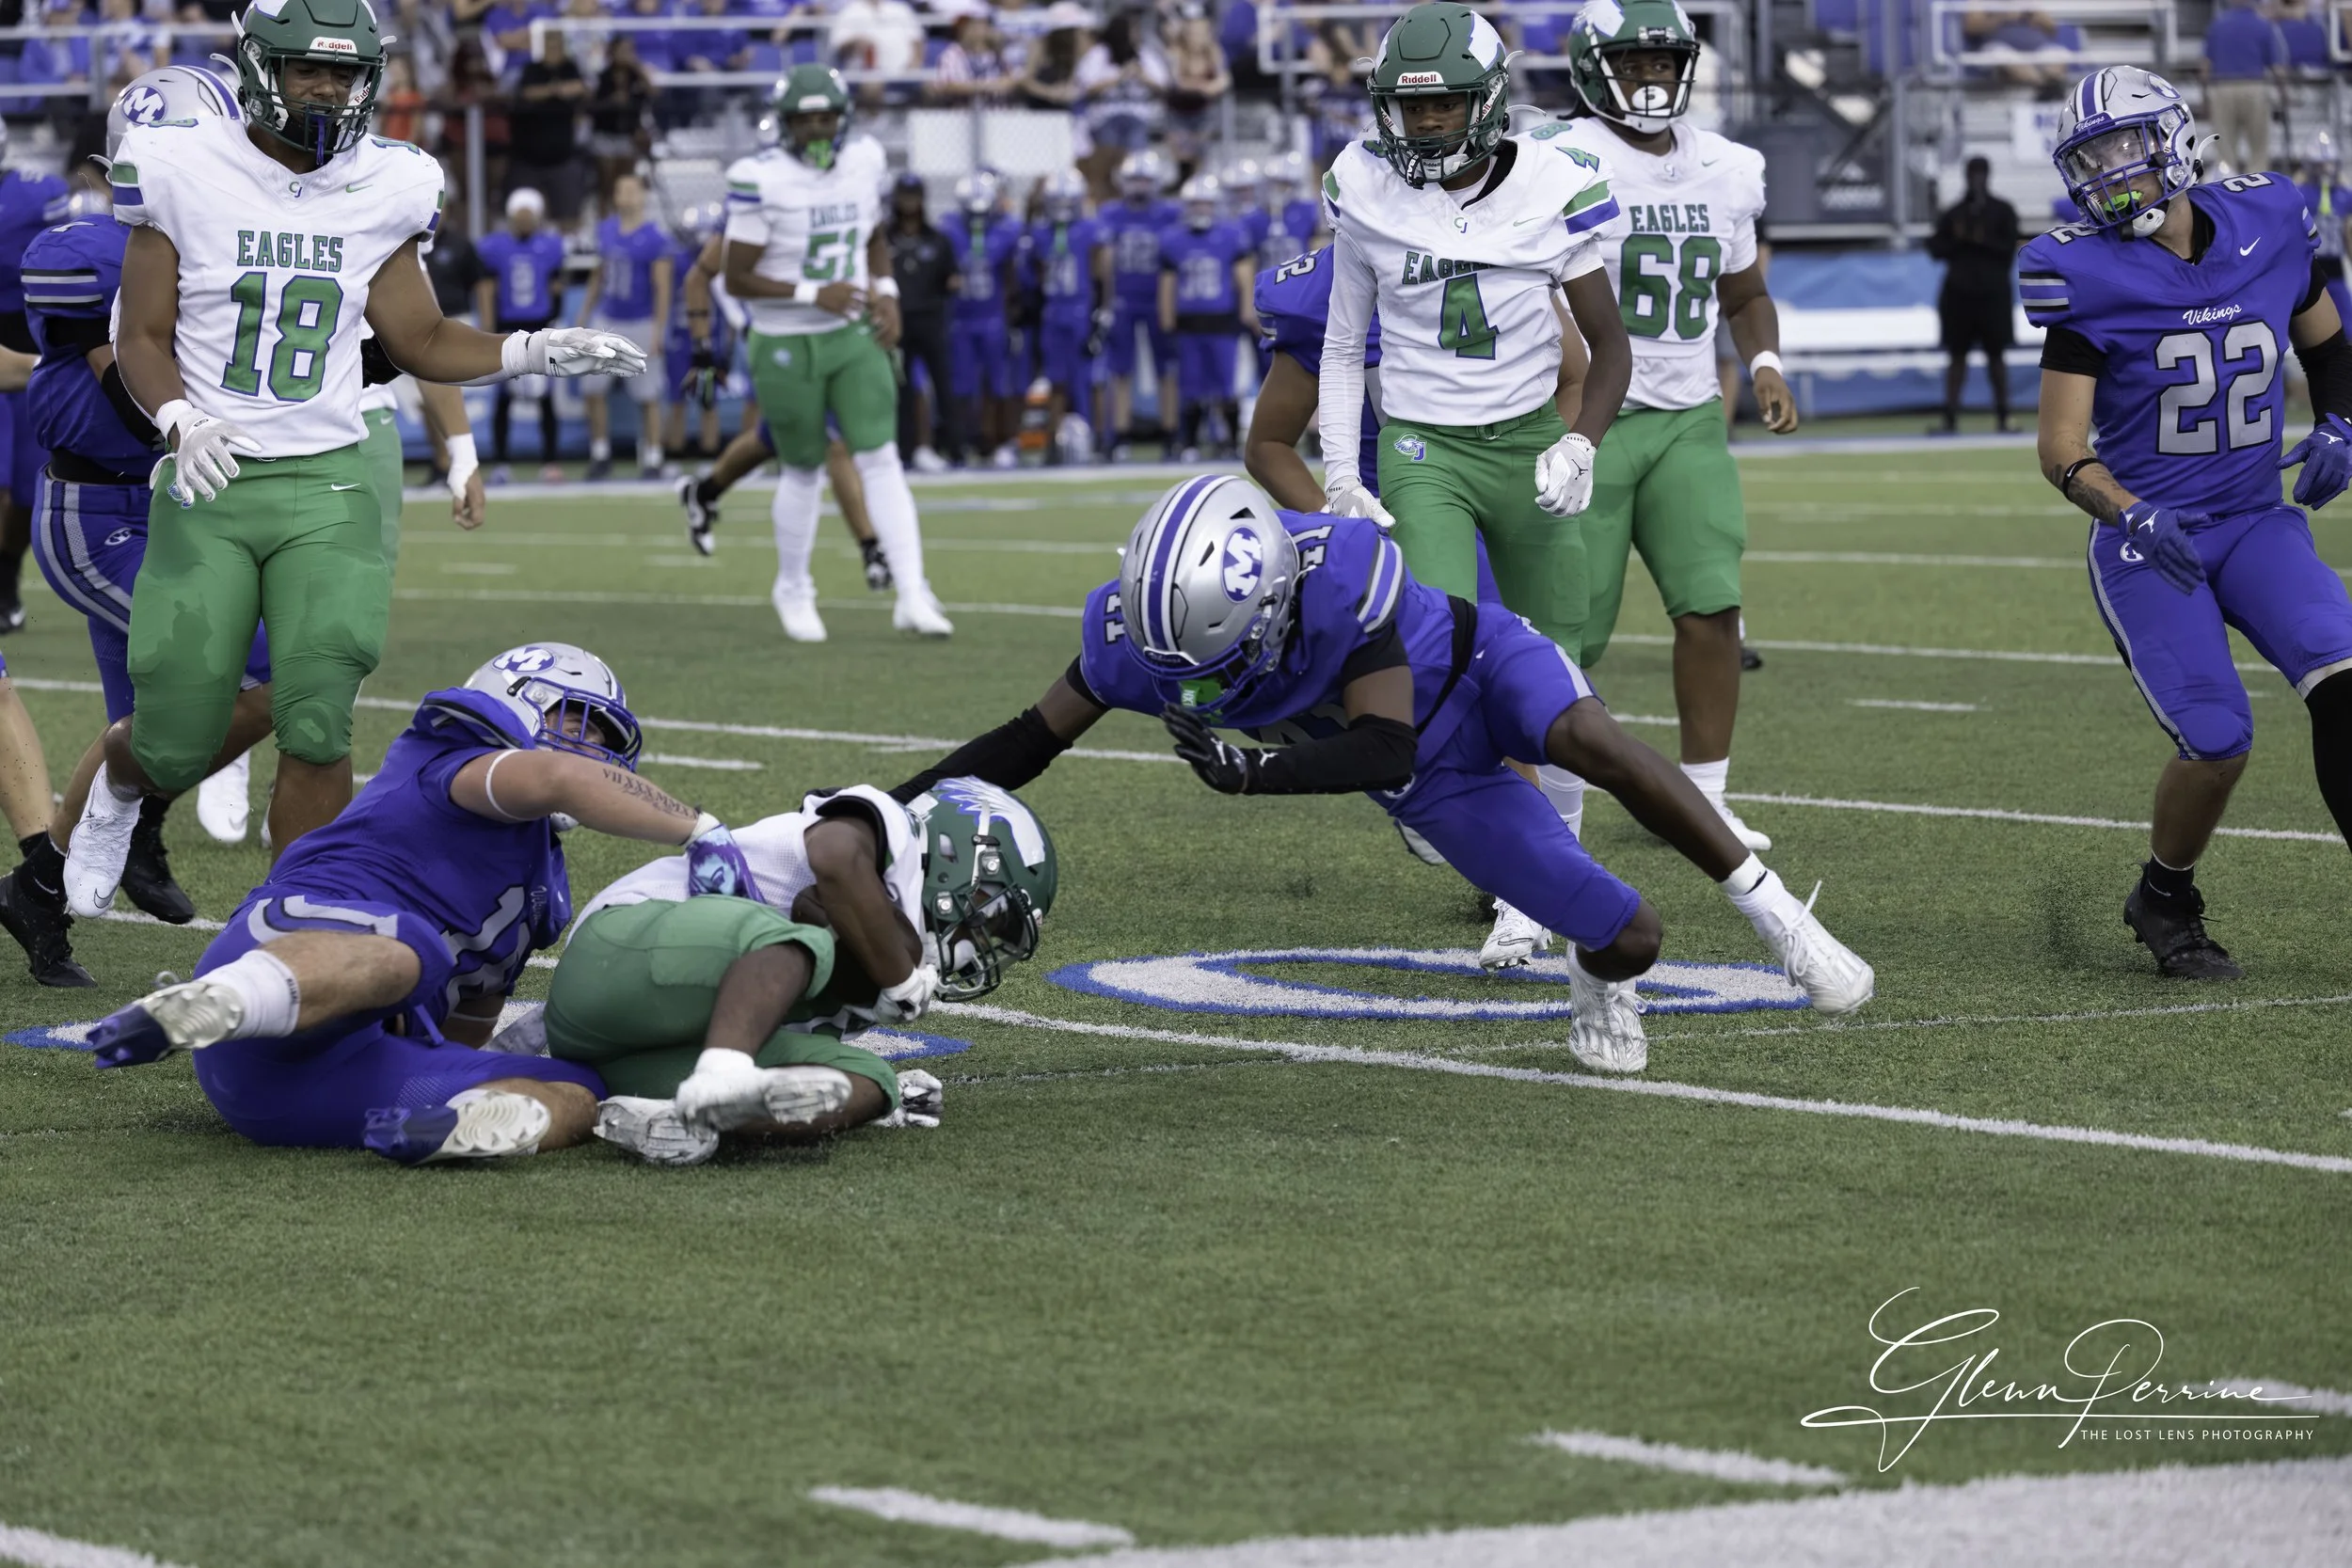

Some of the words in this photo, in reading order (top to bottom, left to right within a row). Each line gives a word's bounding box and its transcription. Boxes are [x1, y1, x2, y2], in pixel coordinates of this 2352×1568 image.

[1401, 74, 1437, 84] Riddell
[1629, 204, 1710, 233] EAGLES
[237, 230, 344, 274] EAGLES
[802, 228, 858, 280] 51
[1438, 273, 1501, 360] 4
[1618, 233, 1723, 341] 68
[2183, 304, 2242, 325] Vikings
[219, 271, 344, 403] 18
[2153, 319, 2280, 456] 22
[1222, 531, 1263, 597] M
